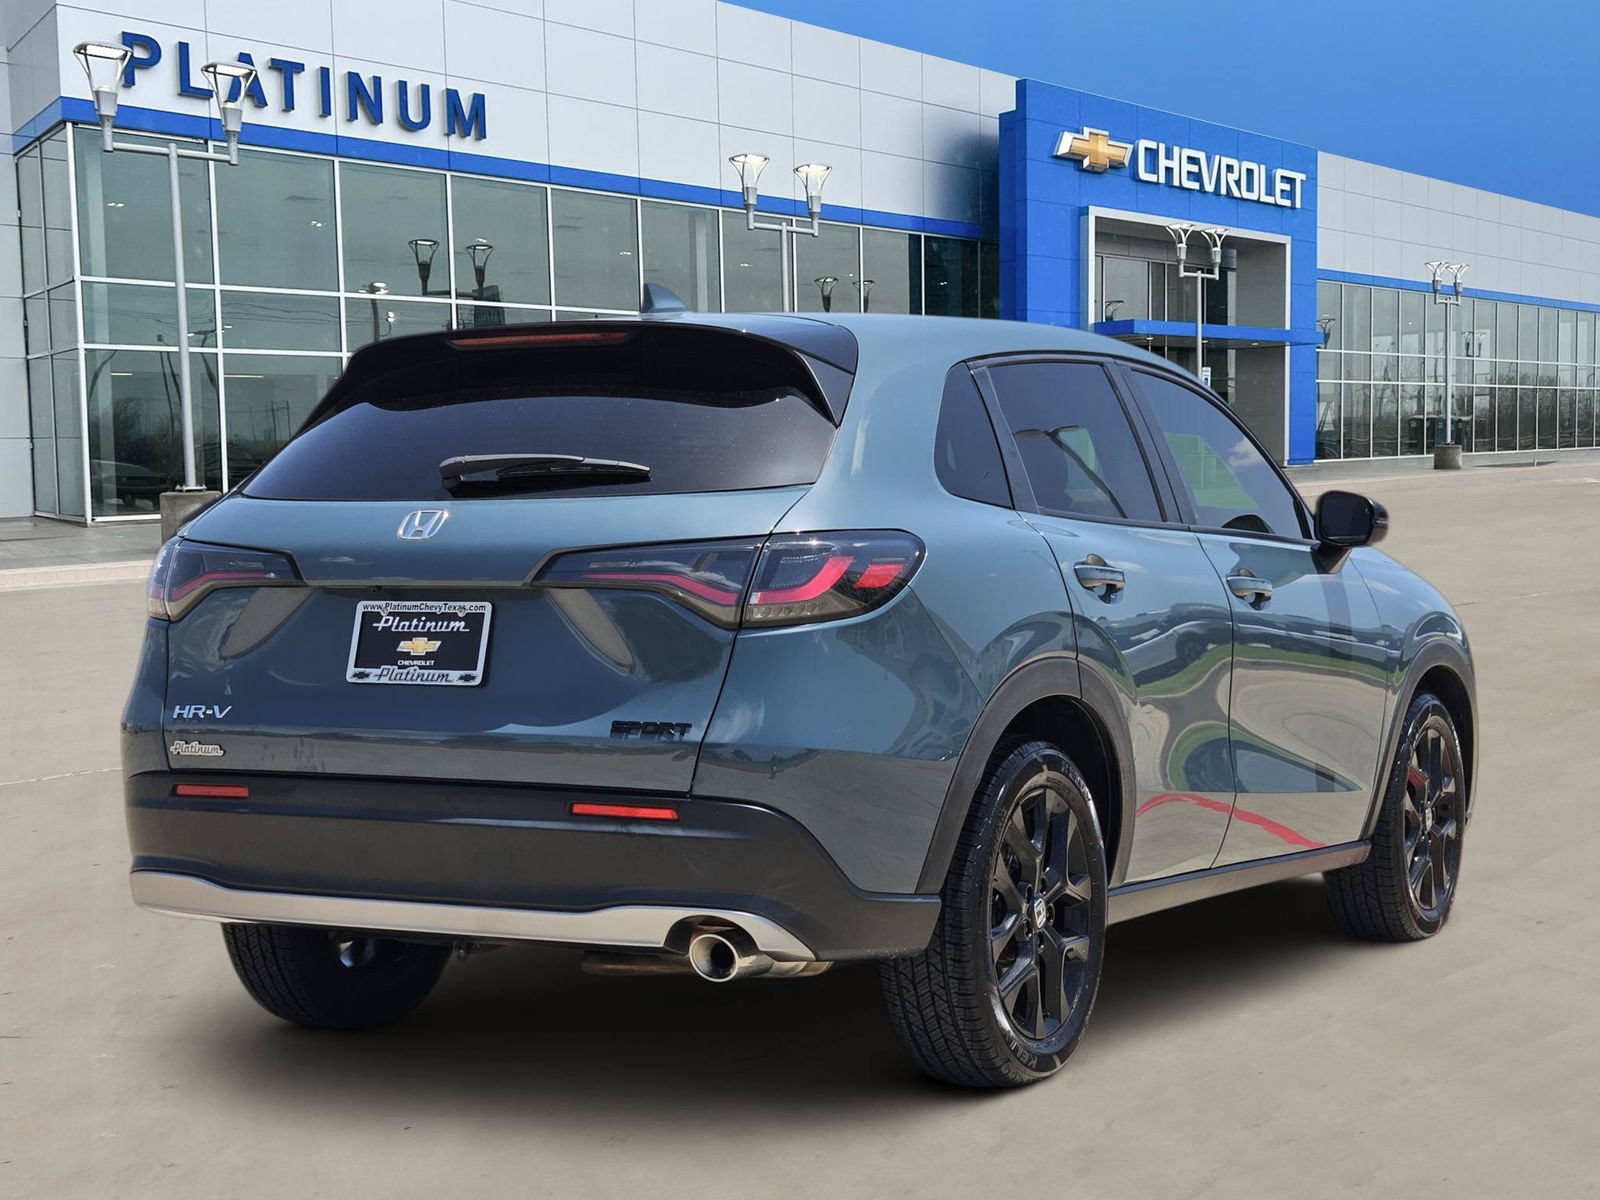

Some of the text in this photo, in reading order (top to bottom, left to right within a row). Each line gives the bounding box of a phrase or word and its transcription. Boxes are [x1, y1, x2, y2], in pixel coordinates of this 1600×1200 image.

[121, 31, 487, 140] PLATINUM
[1136, 139, 1307, 209] CHEVROLET
[373, 616, 470, 631] Platinum
[374, 667, 453, 681] Platinum
[172, 705, 232, 718] HR-V
[170, 741, 224, 756] Platinum
